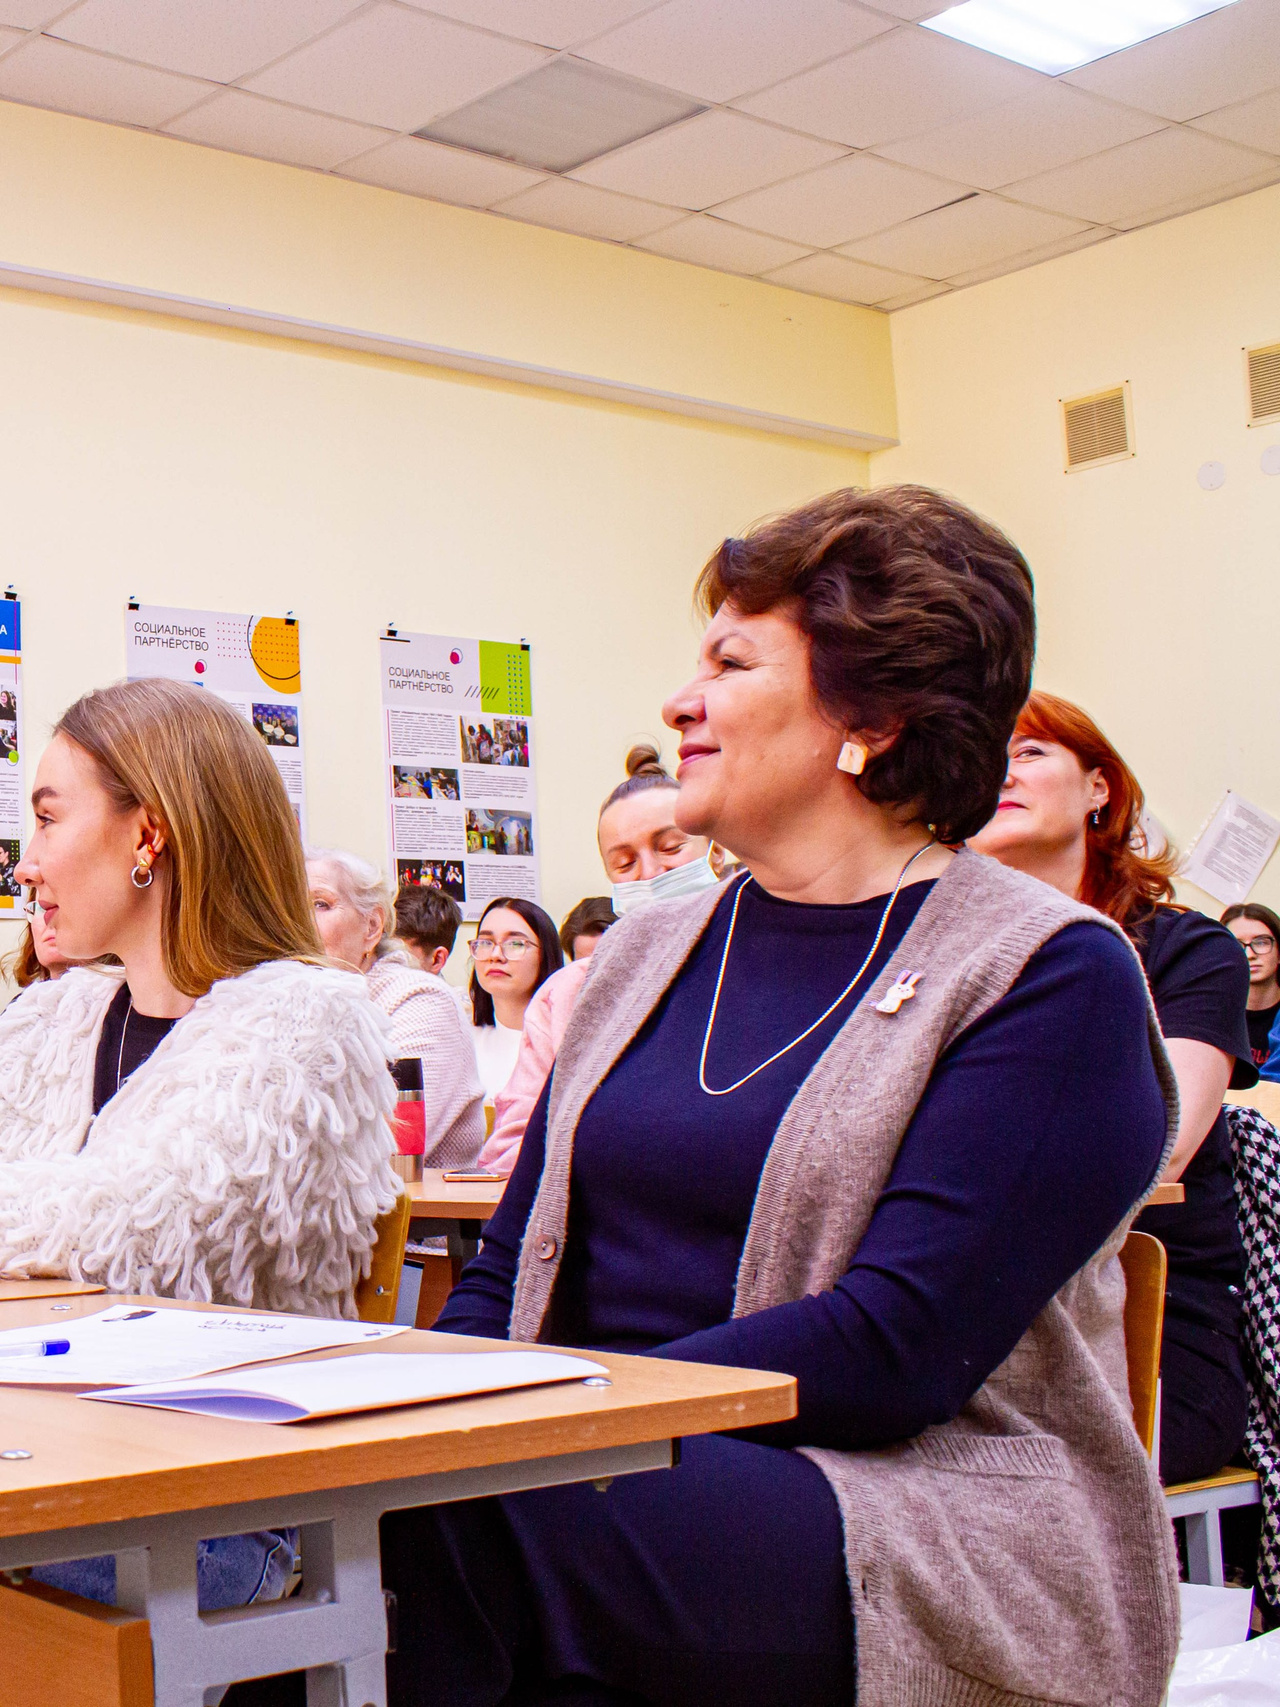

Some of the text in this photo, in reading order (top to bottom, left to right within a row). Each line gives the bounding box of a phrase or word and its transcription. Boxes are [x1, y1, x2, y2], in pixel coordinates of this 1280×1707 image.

[134, 622, 206, 638] СОЦИАЛЬНОЕ
[134, 635, 209, 651] ПАРТНЁРСТВО
[388, 666, 450, 681] СОЦИАЛЬНОЕ
